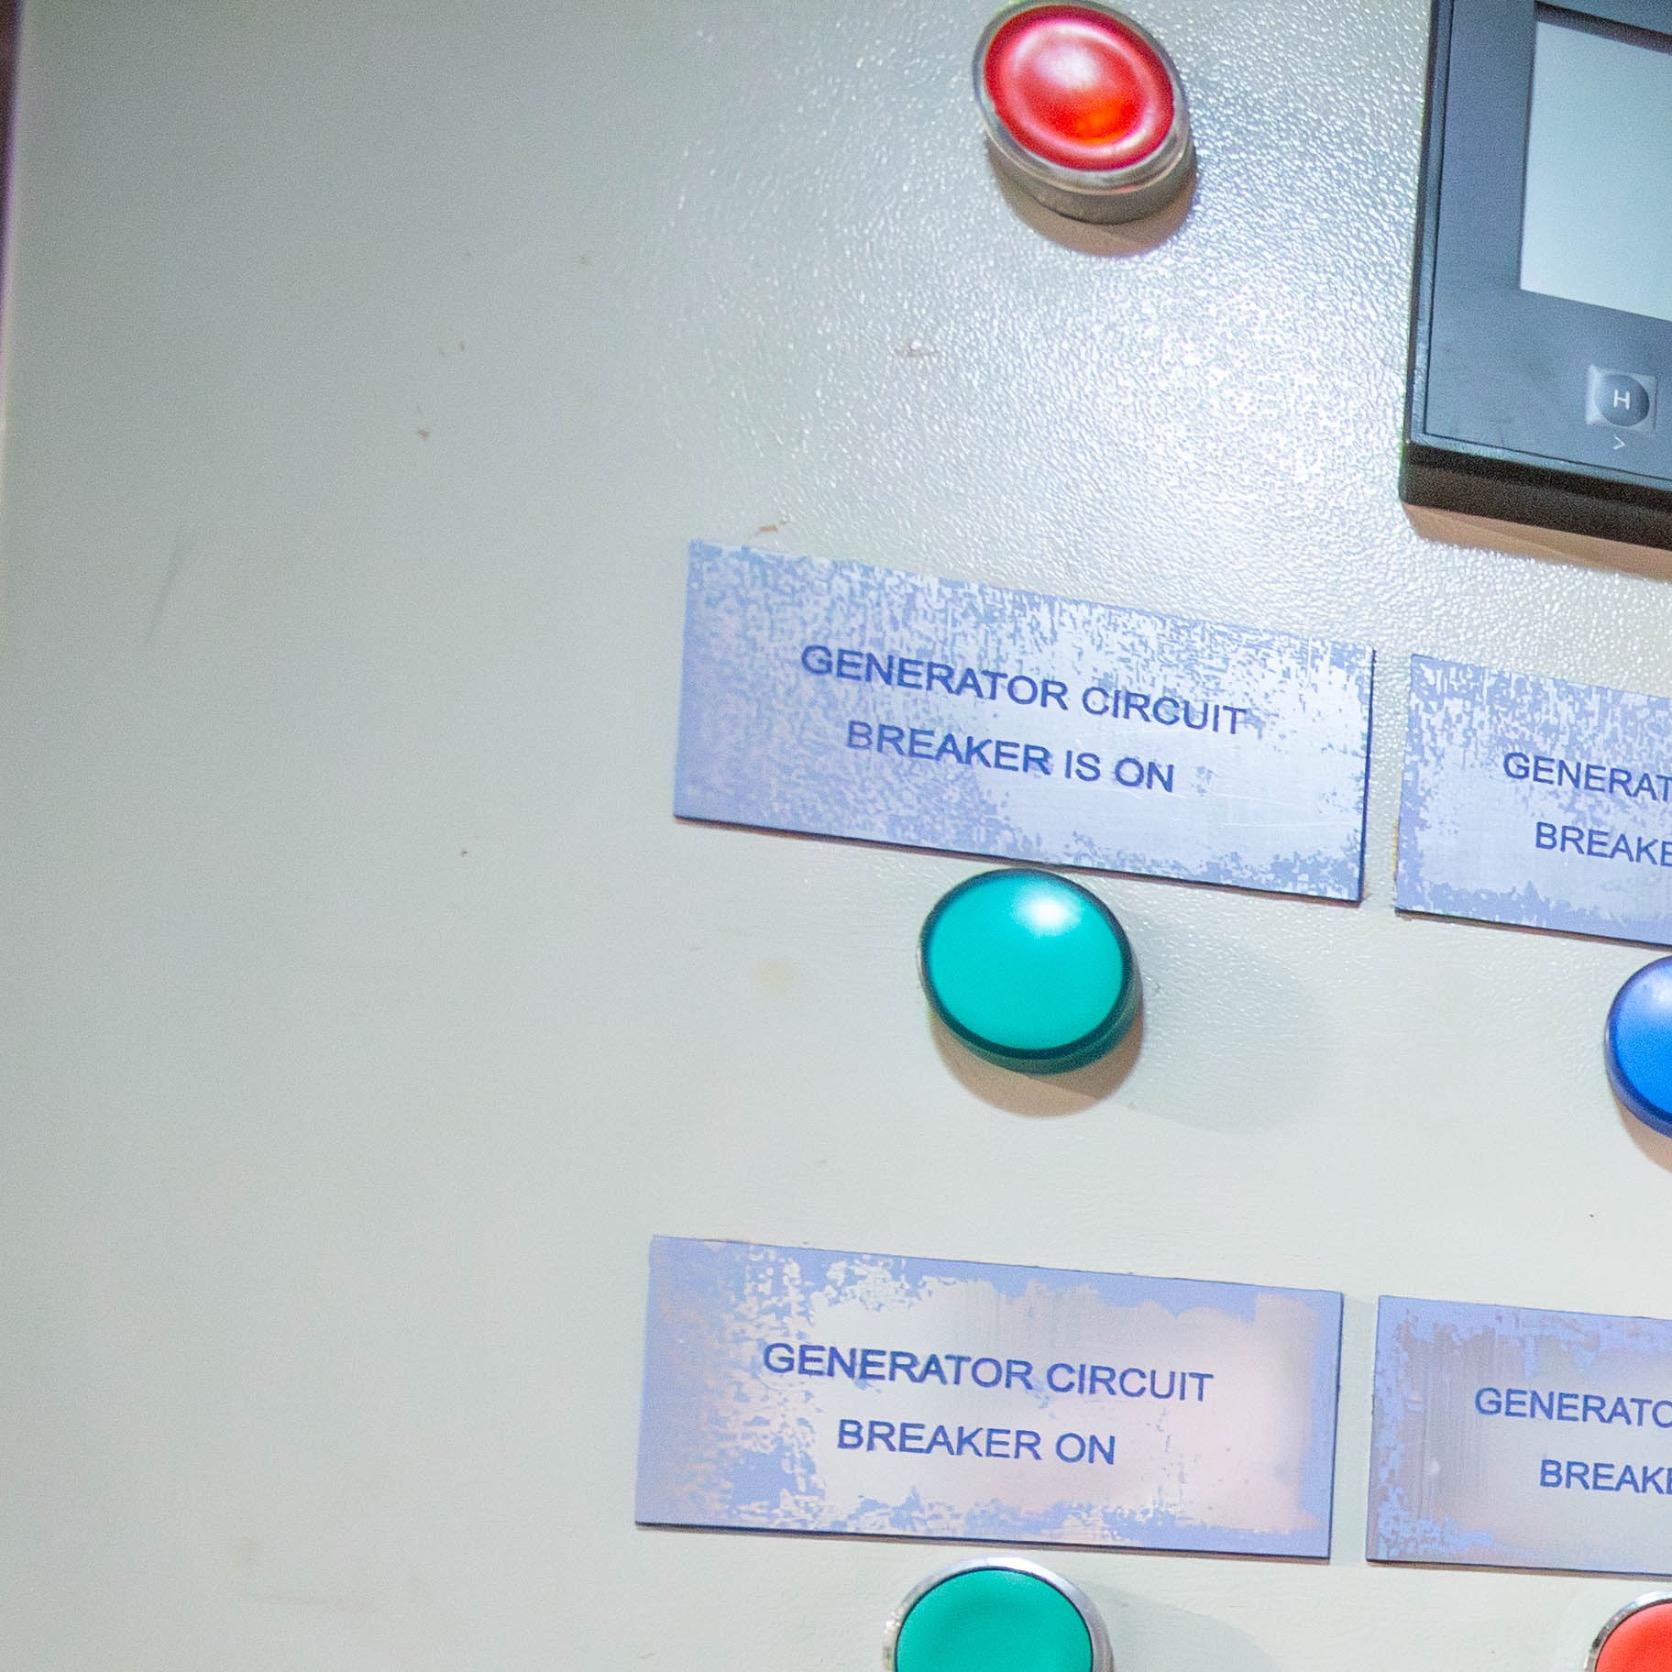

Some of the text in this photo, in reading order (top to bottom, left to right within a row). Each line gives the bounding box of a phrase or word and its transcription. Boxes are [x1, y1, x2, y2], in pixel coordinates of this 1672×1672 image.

[1612, 391, 1631, 410] H
[801, 644, 1248, 736] GENERATOR CIRCUIT
[847, 720, 1175, 793] BREAKER IS ON
[762, 1342, 1213, 1402] GENERATOR CIRCUIT
[836, 1420, 1115, 1465] BREAKER ON
